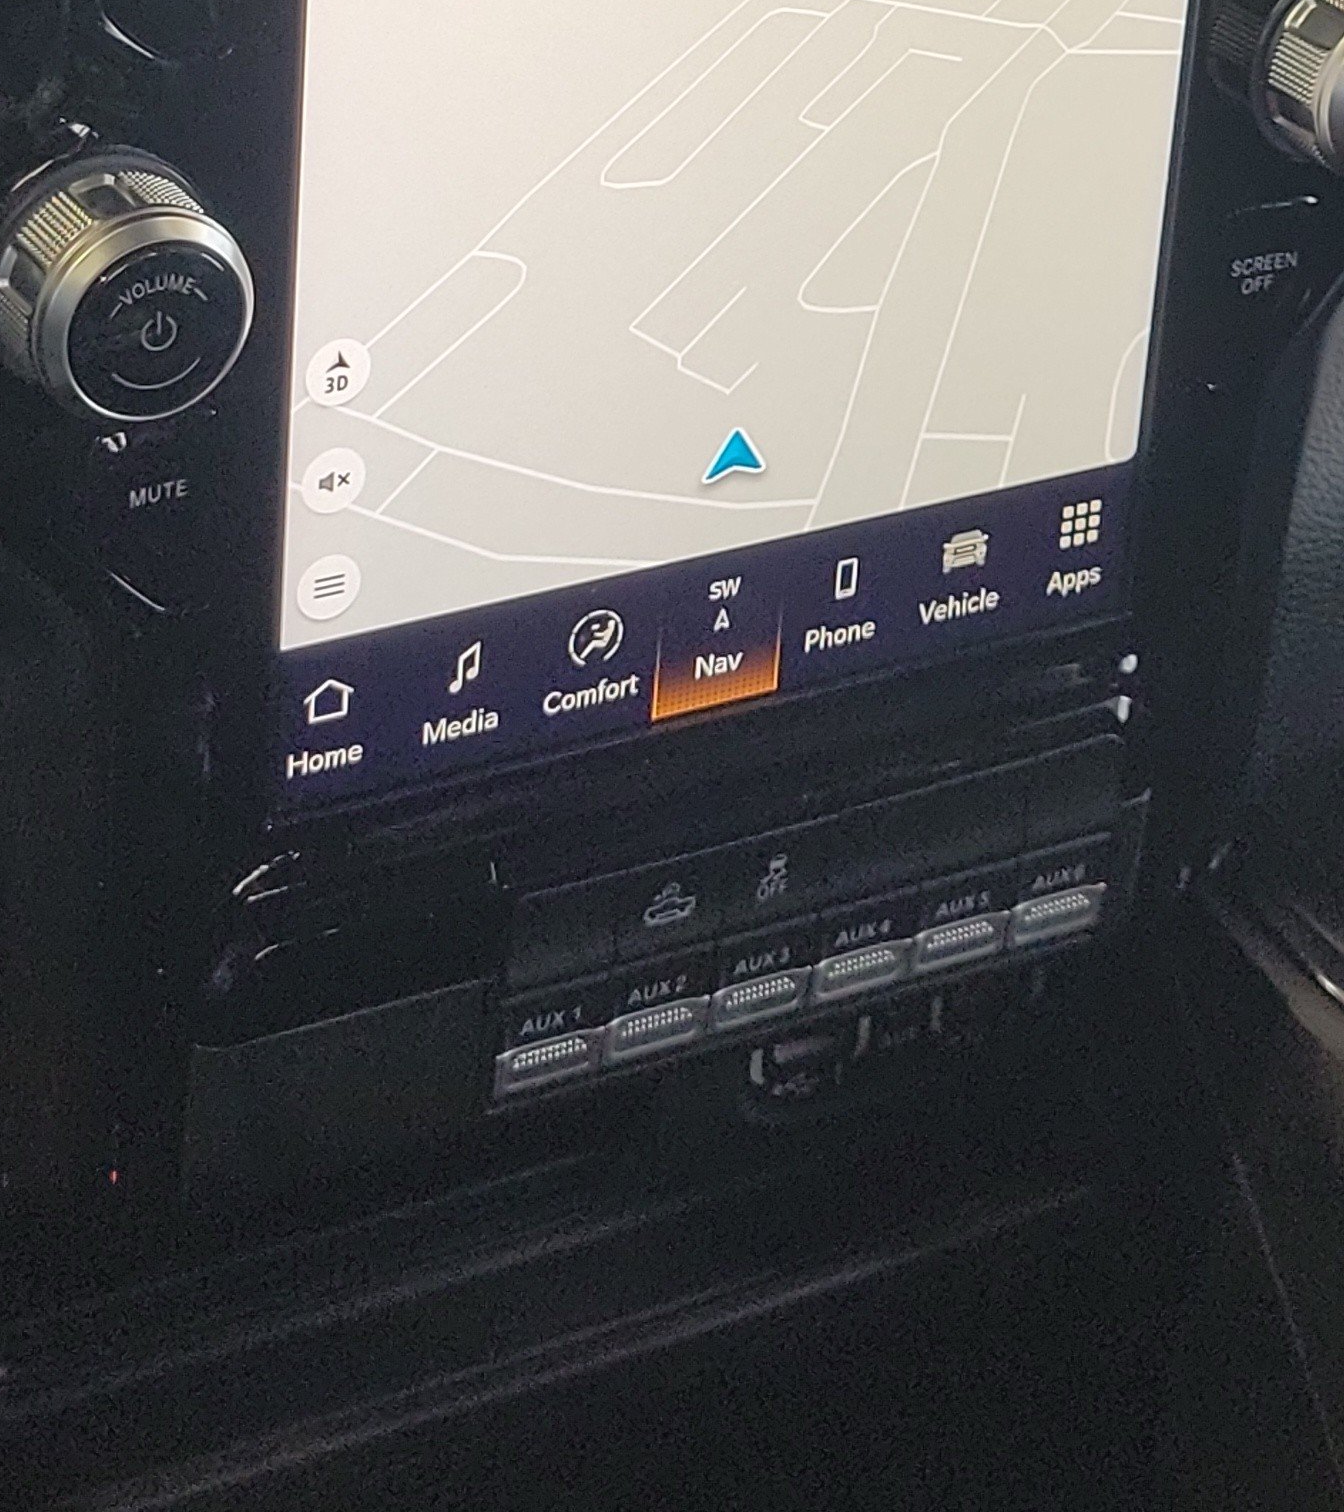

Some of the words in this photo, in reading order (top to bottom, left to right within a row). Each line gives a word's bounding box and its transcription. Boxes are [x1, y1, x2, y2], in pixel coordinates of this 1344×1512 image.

[1230, 251, 1299, 279] SCREEN
[118, 273, 196, 307] VOLUME
[1241, 275, 1273, 294] OFF
[323, 374, 349, 394] 3D
[128, 478, 190, 509] MUTE
[708, 576, 742, 602] SW
[1045, 563, 1103, 598] Apps
[918, 587, 1000, 626] Vehicle
[803, 617, 877, 653] Phone
[694, 648, 744, 681] Nav
[542, 672, 640, 717] Comfort
[422, 707, 500, 747] Media
[286, 740, 364, 779] Home
[1033, 866, 1071, 891] AUX
[934, 894, 976, 919] AUX
[979, 890, 990, 907] 5
[834, 921, 878, 948] AUX
[732, 950, 776, 975] AUX
[778, 946, 791, 964] 3
[627, 978, 671, 1006] AUX
[519, 1009, 567, 1037] AUX
[572, 1005, 583, 1021] 1
